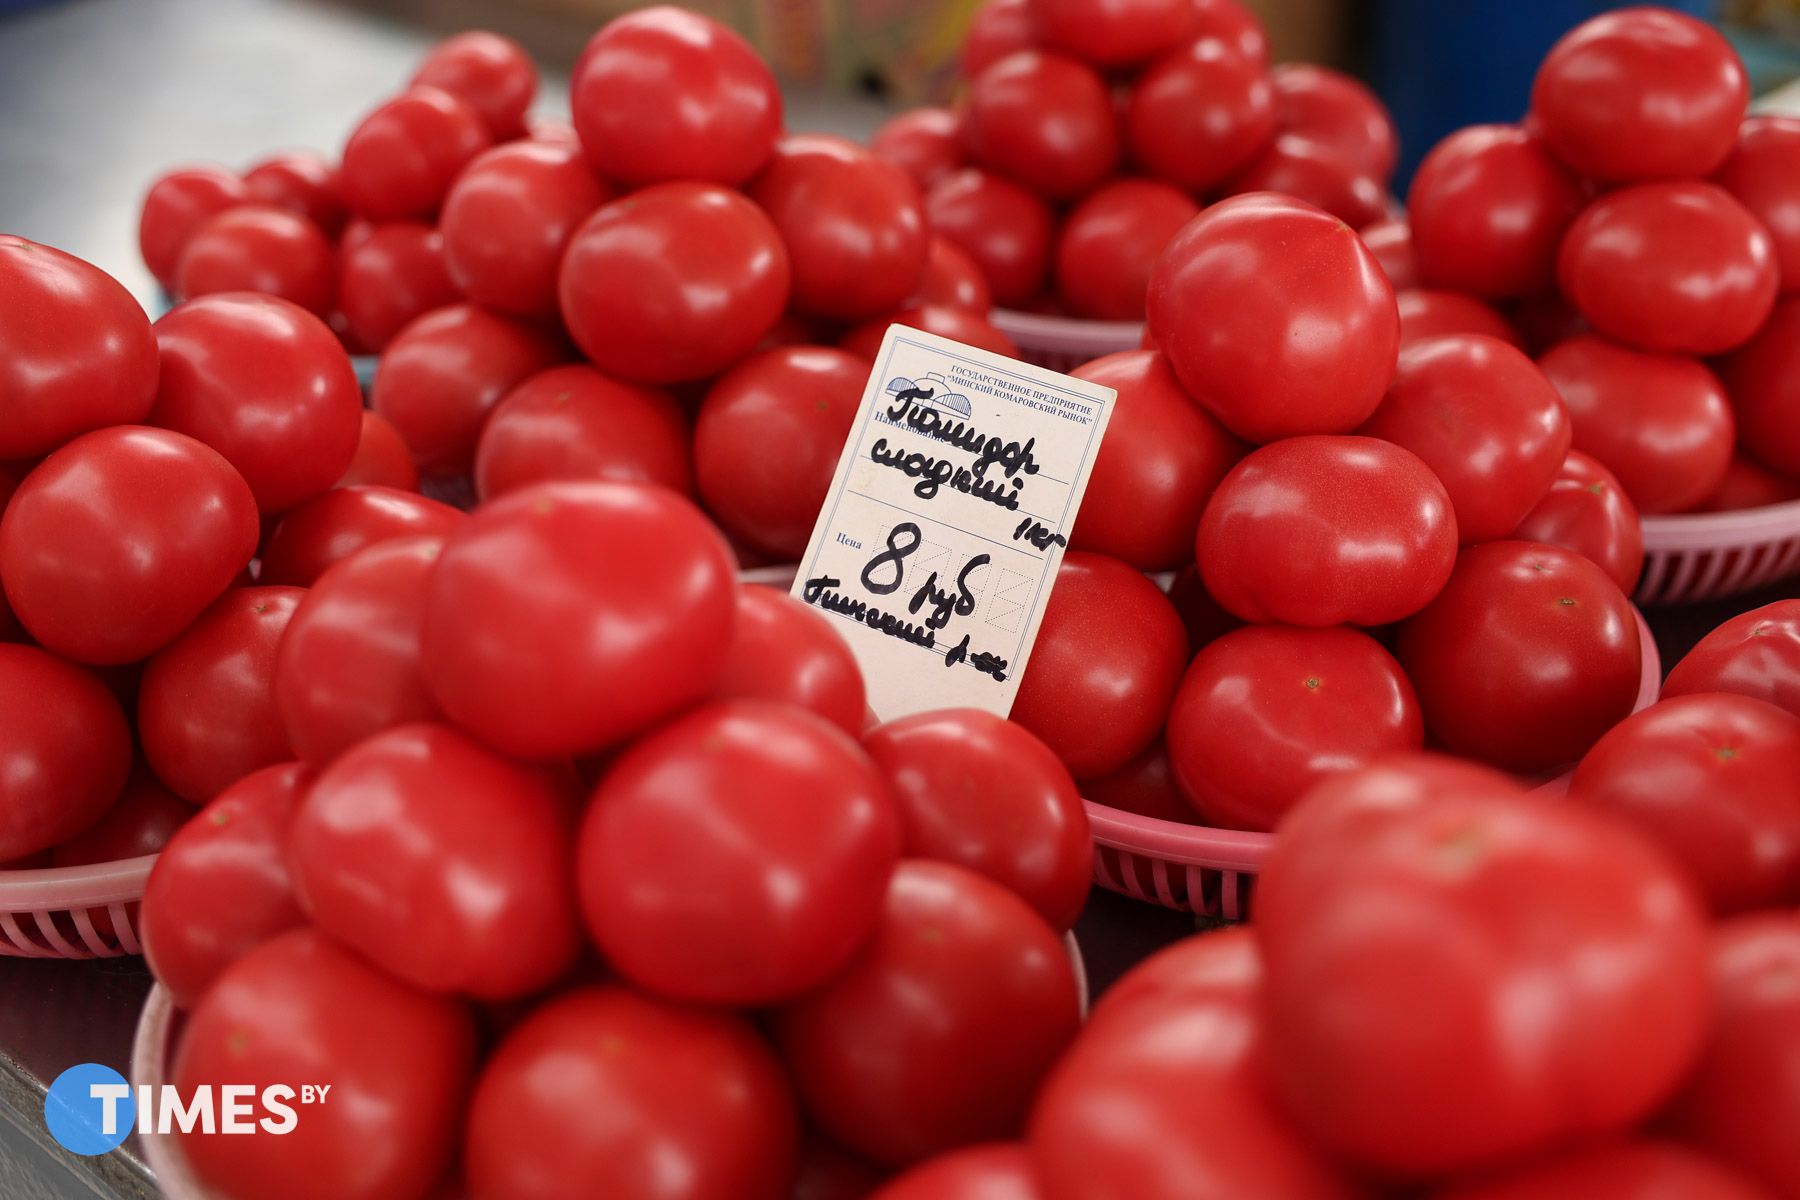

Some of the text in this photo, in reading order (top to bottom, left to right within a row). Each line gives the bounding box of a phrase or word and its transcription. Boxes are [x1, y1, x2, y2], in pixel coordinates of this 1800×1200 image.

[951, 365, 1092, 415] ГОСУДАРСТВЕННОЕ ПРЕДПРИЯТИЕ
[994, 389, 1057, 415] КОМАРОВСКИЙ
[836, 532, 862, 550] Цена
[861, 522, 991, 629] 8 руб
